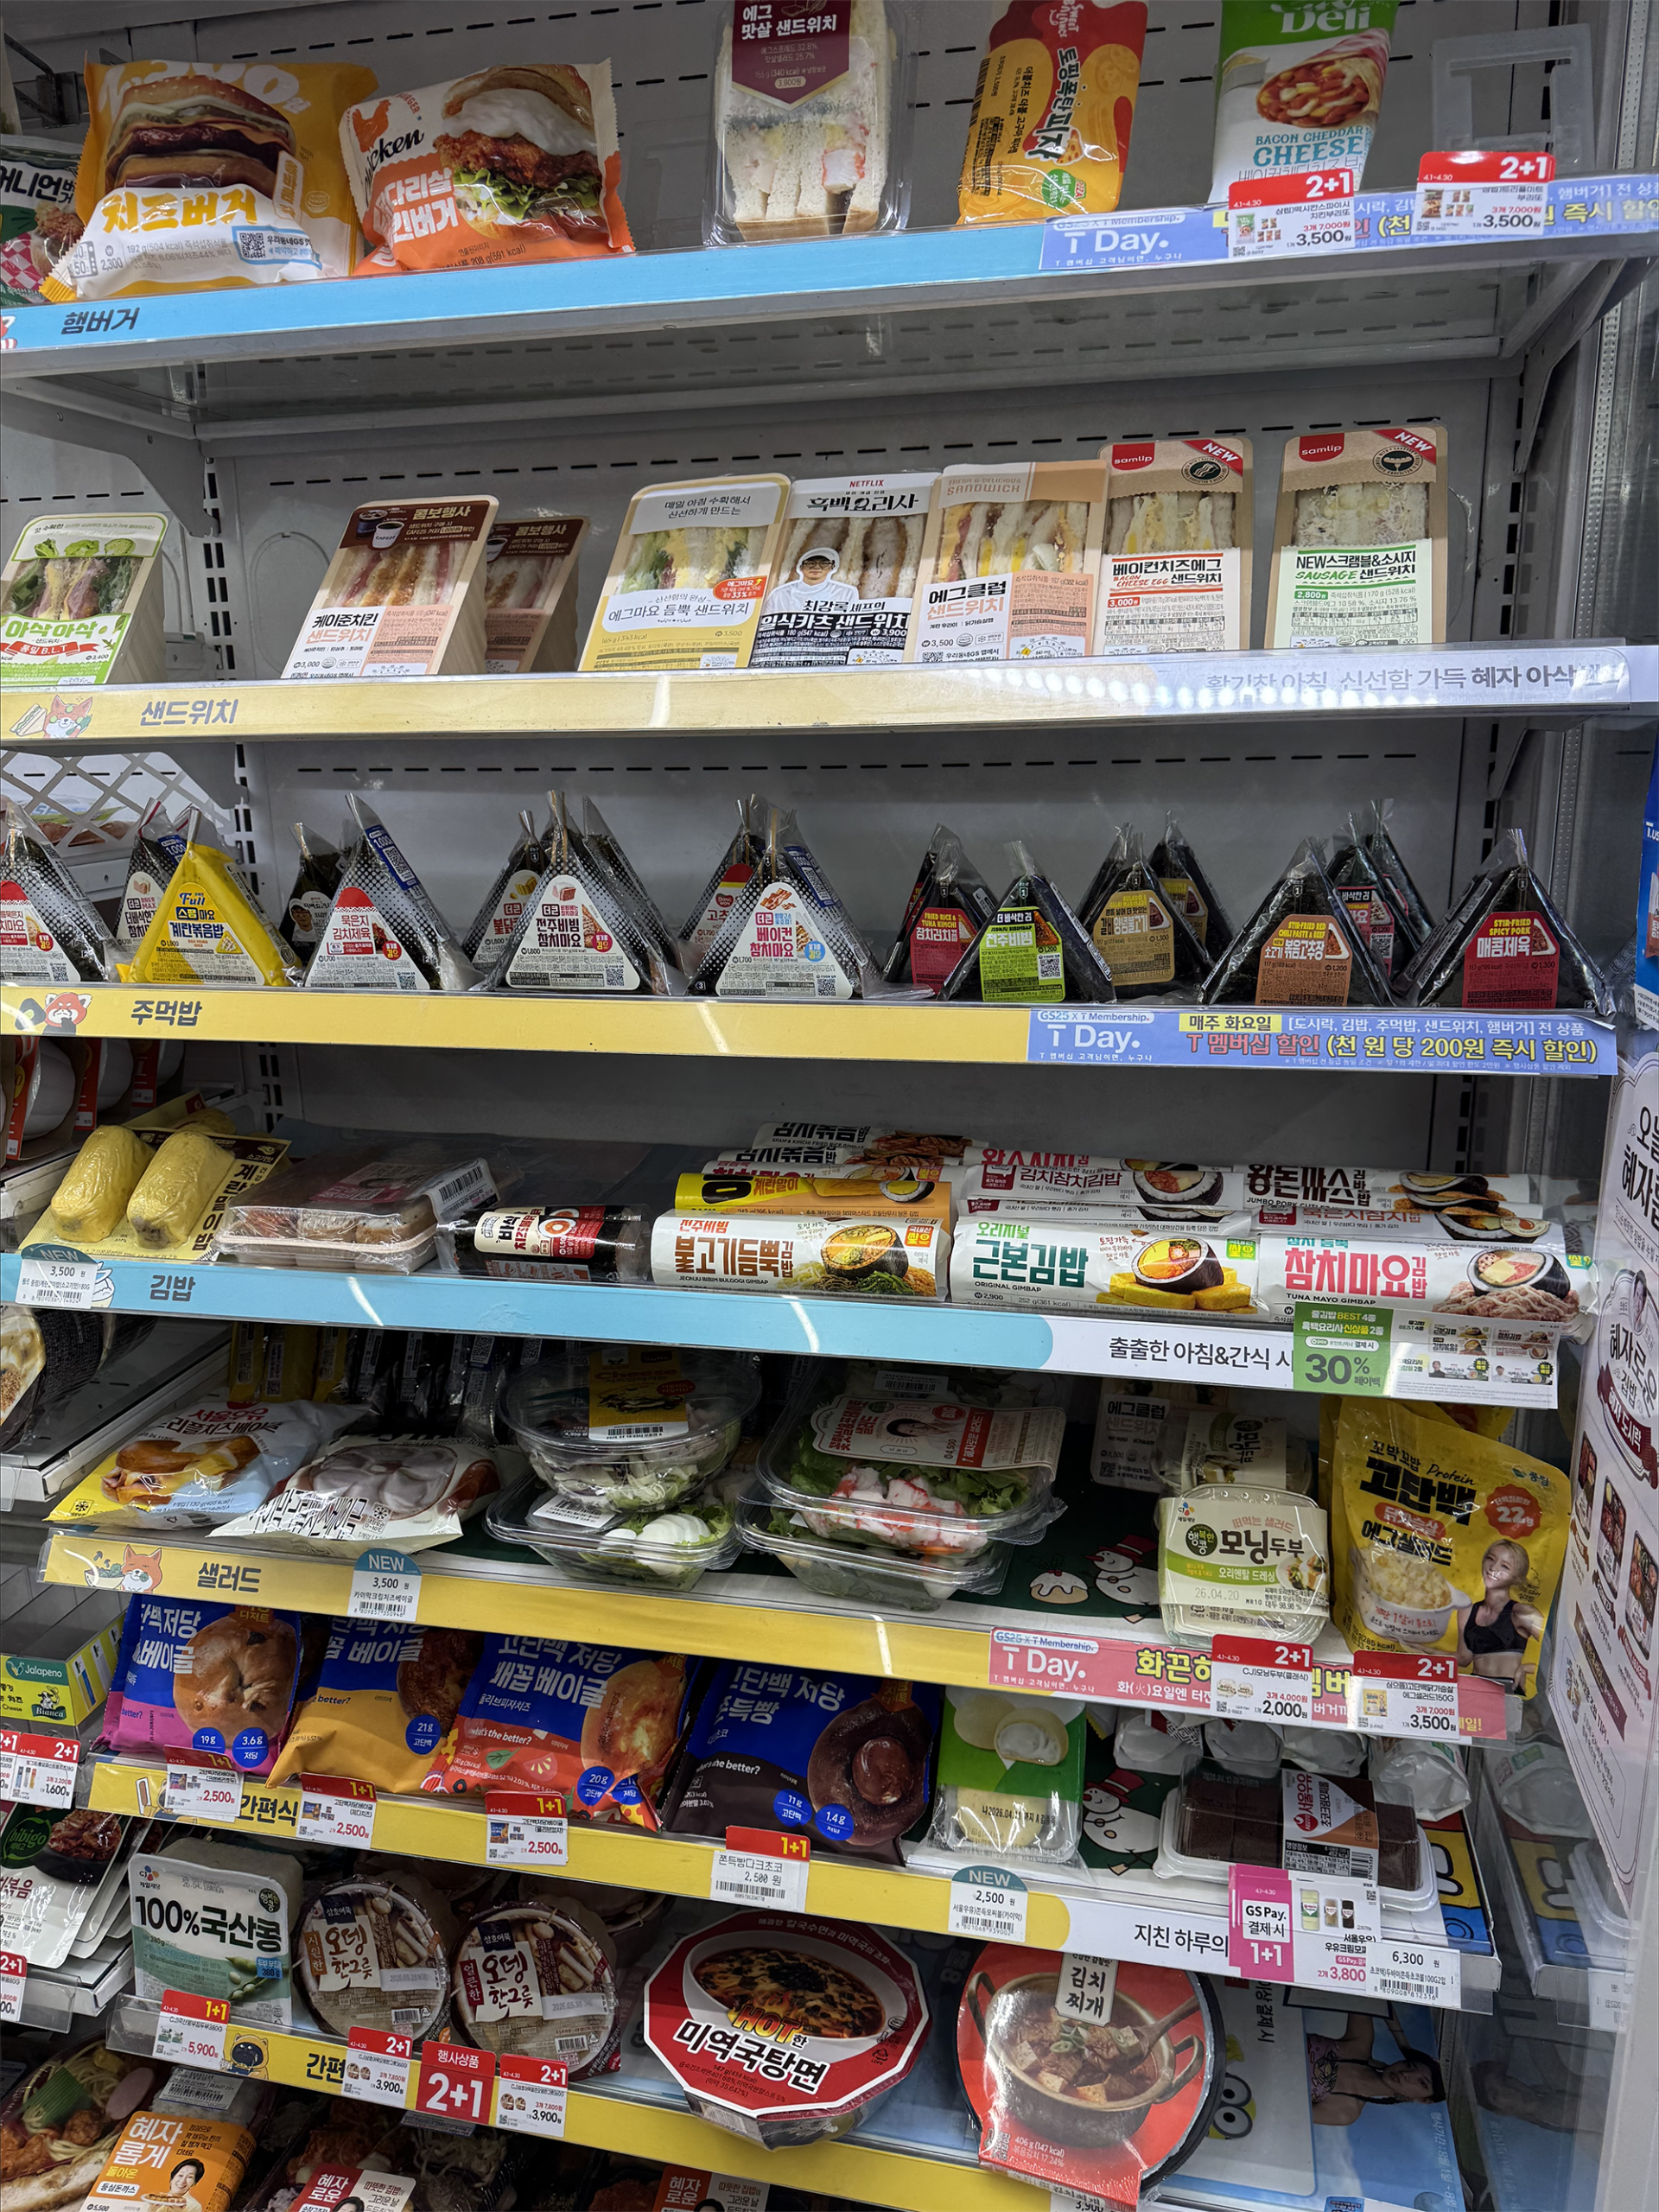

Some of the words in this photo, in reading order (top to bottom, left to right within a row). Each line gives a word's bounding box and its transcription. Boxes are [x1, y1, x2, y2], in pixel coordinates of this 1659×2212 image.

[743, 4, 772, 22] 에그
[1281, 5, 1370, 34] Deli
[741, 22, 772, 40] 맛살
[776, 14, 837, 36] 샌드위치
[778, 77, 802, 86] 3,900원
[1255, 132, 1303, 146] BACON
[1305, 126, 1363, 142] CHEDDAR
[1253, 137, 1363, 168] CHEESE
[1499, 156, 1548, 180] 2+1
[1306, 171, 1350, 198] 2+1
[102, 188, 258, 233] 치즈버거
[1310, 209, 1351, 219] 치킨부리또
[100, 257, 124, 272] 2,300
[61, 307, 141, 335] 햄버거
[1300, 443, 1342, 458] samlip
[1395, 431, 1433, 453] NEW
[1115, 454, 1153, 467] samlip
[1202, 442, 1238, 464] NEW
[849, 480, 884, 488] NETFLIX
[947, 484, 1020, 496] SANDWICH
[664, 499, 685, 510] 매일
[688, 498, 707, 508] 아침
[709, 495, 751, 506] 수확해서
[668, 506, 708, 519] 신선하게
[710, 505, 741, 517] 만드는
[806, 493, 919, 513] 흑백요리사
[411, 505, 472, 520] 콤보행사
[515, 524, 567, 537] 콤보행사
[1113, 559, 1222, 577] 베이컨치즈에그
[1296, 551, 1416, 570] NEW스크램블&소시지
[1152, 578, 1169, 587] EGG
[1171, 572, 1222, 585] 샌드위치
[1295, 570, 1357, 582] SAUSAGE
[1359, 565, 1415, 580] 샌드위치
[929, 581, 1007, 602] 에그클럽
[608, 606, 659, 623] 에그마요
[694, 601, 750, 617] 샌드위치
[927, 598, 1004, 620] 샌드위치
[5, 620, 99, 639] 아삭아삭
[311, 613, 379, 629] 케이준치킨
[306, 628, 373, 645] 샌드위치
[881, 629, 907, 638] 3,900
[931, 639, 954, 647] 3,500
[300, 659, 320, 670] 3,000
[139, 699, 240, 728] 샌드위치
[341, 914, 370, 927] 묵은지
[536, 918, 581, 932] 전주비빔
[925, 912, 939, 921] FRIED
[940, 913, 951, 922] RICE
[1493, 918, 1532, 927] STIR-FRIED
[169, 922, 225, 939] 계란볶음밥
[333, 927, 372, 941] 김치제육
[757, 927, 792, 942] 베이컨
[986, 931, 1033, 948] 전주비빔
[537, 932, 582, 949] 참치마요
[1477, 936, 1530, 958] 매콤제육
[750, 943, 794, 958] 참치마요
[131, 1000, 203, 1027] 주먹밥
[1189, 1015, 1220, 1031] 매주
[1225, 1015, 1272, 1032] 화요일
[1288, 1018, 1338, 1033] [도시락,
[1341, 1018, 1372, 1033] 김밥,
[1376, 1019, 1421, 1033] 주먹밥,
[1424, 1020, 1484, 1035] 샌드위치,
[1487, 1020, 1535, 1036] 햄버거]
[1539, 1022, 1553, 1036] 전
[1556, 1022, 1586, 1037] 상품
[1047, 1024, 1067, 1046] T
[1075, 1025, 1141, 1053] Day.
[753, 1178, 799, 1197] 계란말이
[680, 1219, 729, 1234] 전주비빔
[976, 1223, 1030, 1240] 오리지널
[973, 1239, 1089, 1288] 근본김밥
[1285, 1250, 1410, 1298] 참치마요
[1412, 1257, 1427, 1300] 김밥
[149, 1274, 197, 1303] 김밥
[975, 1281, 1010, 1290] ORIGINAL
[1286, 1294, 1304, 1302] TUNA
[1306, 1295, 1338, 1304] MAYO
[1109, 1337, 1170, 1363] 출출한
[1174, 1341, 1271, 1370] 아침&간식
[1107, 1399, 1165, 1420] 에그클럽
[1359, 1456, 1477, 1526] 고단백
[1218, 1529, 1306, 1565] 모닝두부
[369, 1554, 405, 1572] NEW
[198, 1561, 262, 1594] 샐러드
[372, 1576, 399, 1589] 3,500
[1218, 1567, 1250, 1581] 오리엔탈
[1251, 1568, 1276, 1583] 드레싱
[353, 1590, 414, 1604] 카이막크림치즈베이글
[1194, 1586, 1240, 1601] 26.04.20
[1002, 1646, 1020, 1670] T
[1027, 1649, 1087, 1682] Day.
[1274, 1645, 1311, 1668] 2+1
[25, 1664, 63, 1678] Jalapeno
[1417, 1657, 1455, 1680] 2+1
[791, 1679, 847, 1713] 저당
[35, 1706, 65, 1718] Bianca
[413, 1738, 433, 1748] 고단백
[488, 1729, 502, 1738] the
[502, 1731, 532, 1745] better?
[54, 1741, 79, 1762] 2+1
[208, 1755, 234, 1770] 1+1
[351, 1781, 374, 1800] 1+1
[537, 1798, 563, 1815] 1+1
[780, 1836, 809, 1858] 1+1
[718, 1854, 783, 1874] 쫀득빵다크초코
[969, 1870, 1011, 1887] NEW
[976, 1890, 1005, 1904] 2,500
[1009, 1898, 1016, 1907] 원
[1248, 1920, 1272, 1936] 결제
[1274, 1923, 1286, 1938] 시
[325, 1923, 367, 1958] 오뎅
[1134, 1923, 1173, 1948] 지친
[1174, 1927, 1229, 1959] 하루의
[1249, 1942, 1283, 1967] 1+1
[1392, 1951, 1424, 1967] 6,300
[1433, 1959, 1441, 1970] 원
[331, 1955, 373, 1981] 한그릇
[482, 1951, 529, 1985] 오뎅
[1317, 1968, 1329, 1979] 2개
[1329, 1967, 1366, 1982] 3,800
[1070, 1966, 1107, 1994] 김치
[488, 1983, 534, 2011] 한그릇
[1065, 1990, 1105, 2019] 찌개
[205, 2000, 227, 2021] 1+1
[733, 2005, 802, 2044] HOT
[791, 2033, 810, 2050] 한
[385, 2036, 411, 2057] 2+1
[673, 2018, 831, 2094] 미역국탕면
[437, 2048, 480, 2069] 행사상품
[540, 2064, 567, 2086] 2+1
[426, 2072, 483, 2120] 2+1
[128, 2116, 183, 2146] 혜자
[112, 2140, 172, 2170] 롭게
[106, 2165, 138, 2180] 돌아온
[315, 2173, 349, 2191] 혜자
[100, 2181, 137, 2196] 등심돈까스
[308, 2186, 342, 2204] 로운
